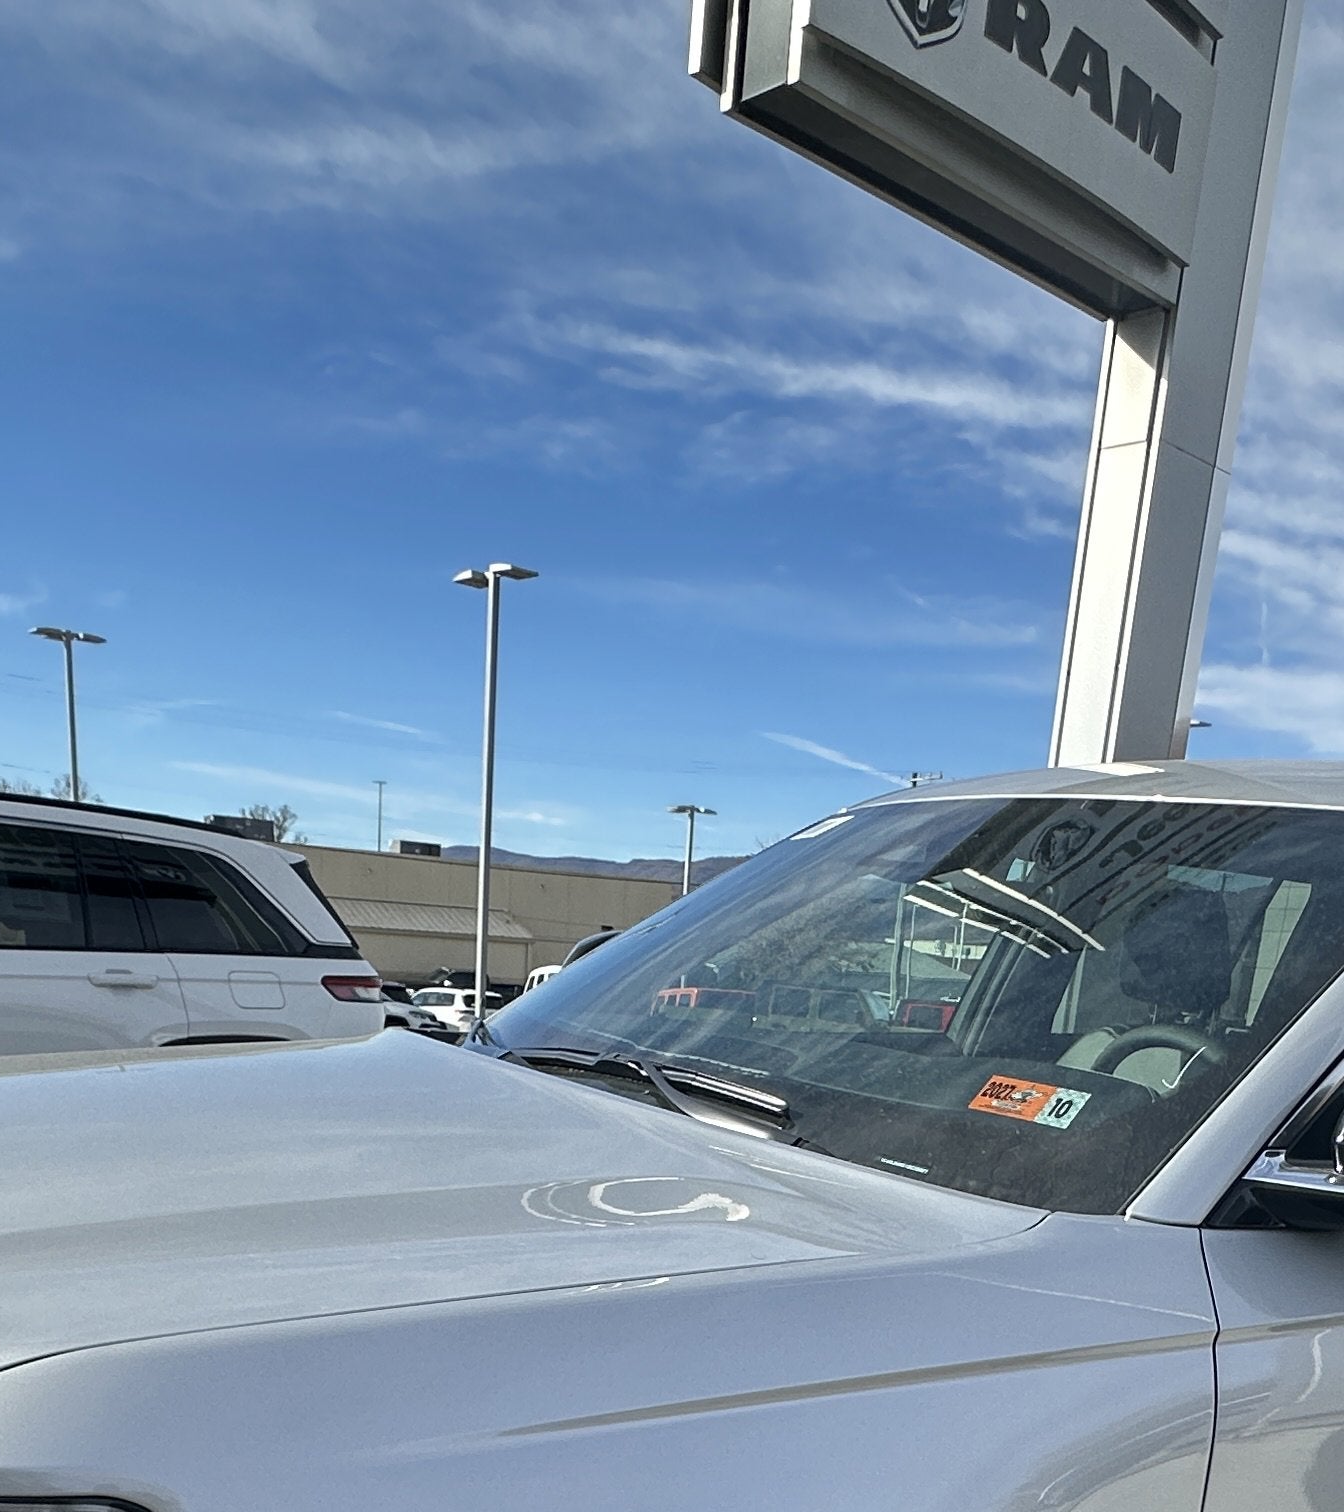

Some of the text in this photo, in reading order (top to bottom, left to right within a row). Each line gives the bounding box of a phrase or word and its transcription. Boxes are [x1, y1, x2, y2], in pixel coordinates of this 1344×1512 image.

[983, 0, 1182, 175] RAM
[981, 1081, 1017, 1101] 2027
[1047, 1097, 1074, 1119] 10
